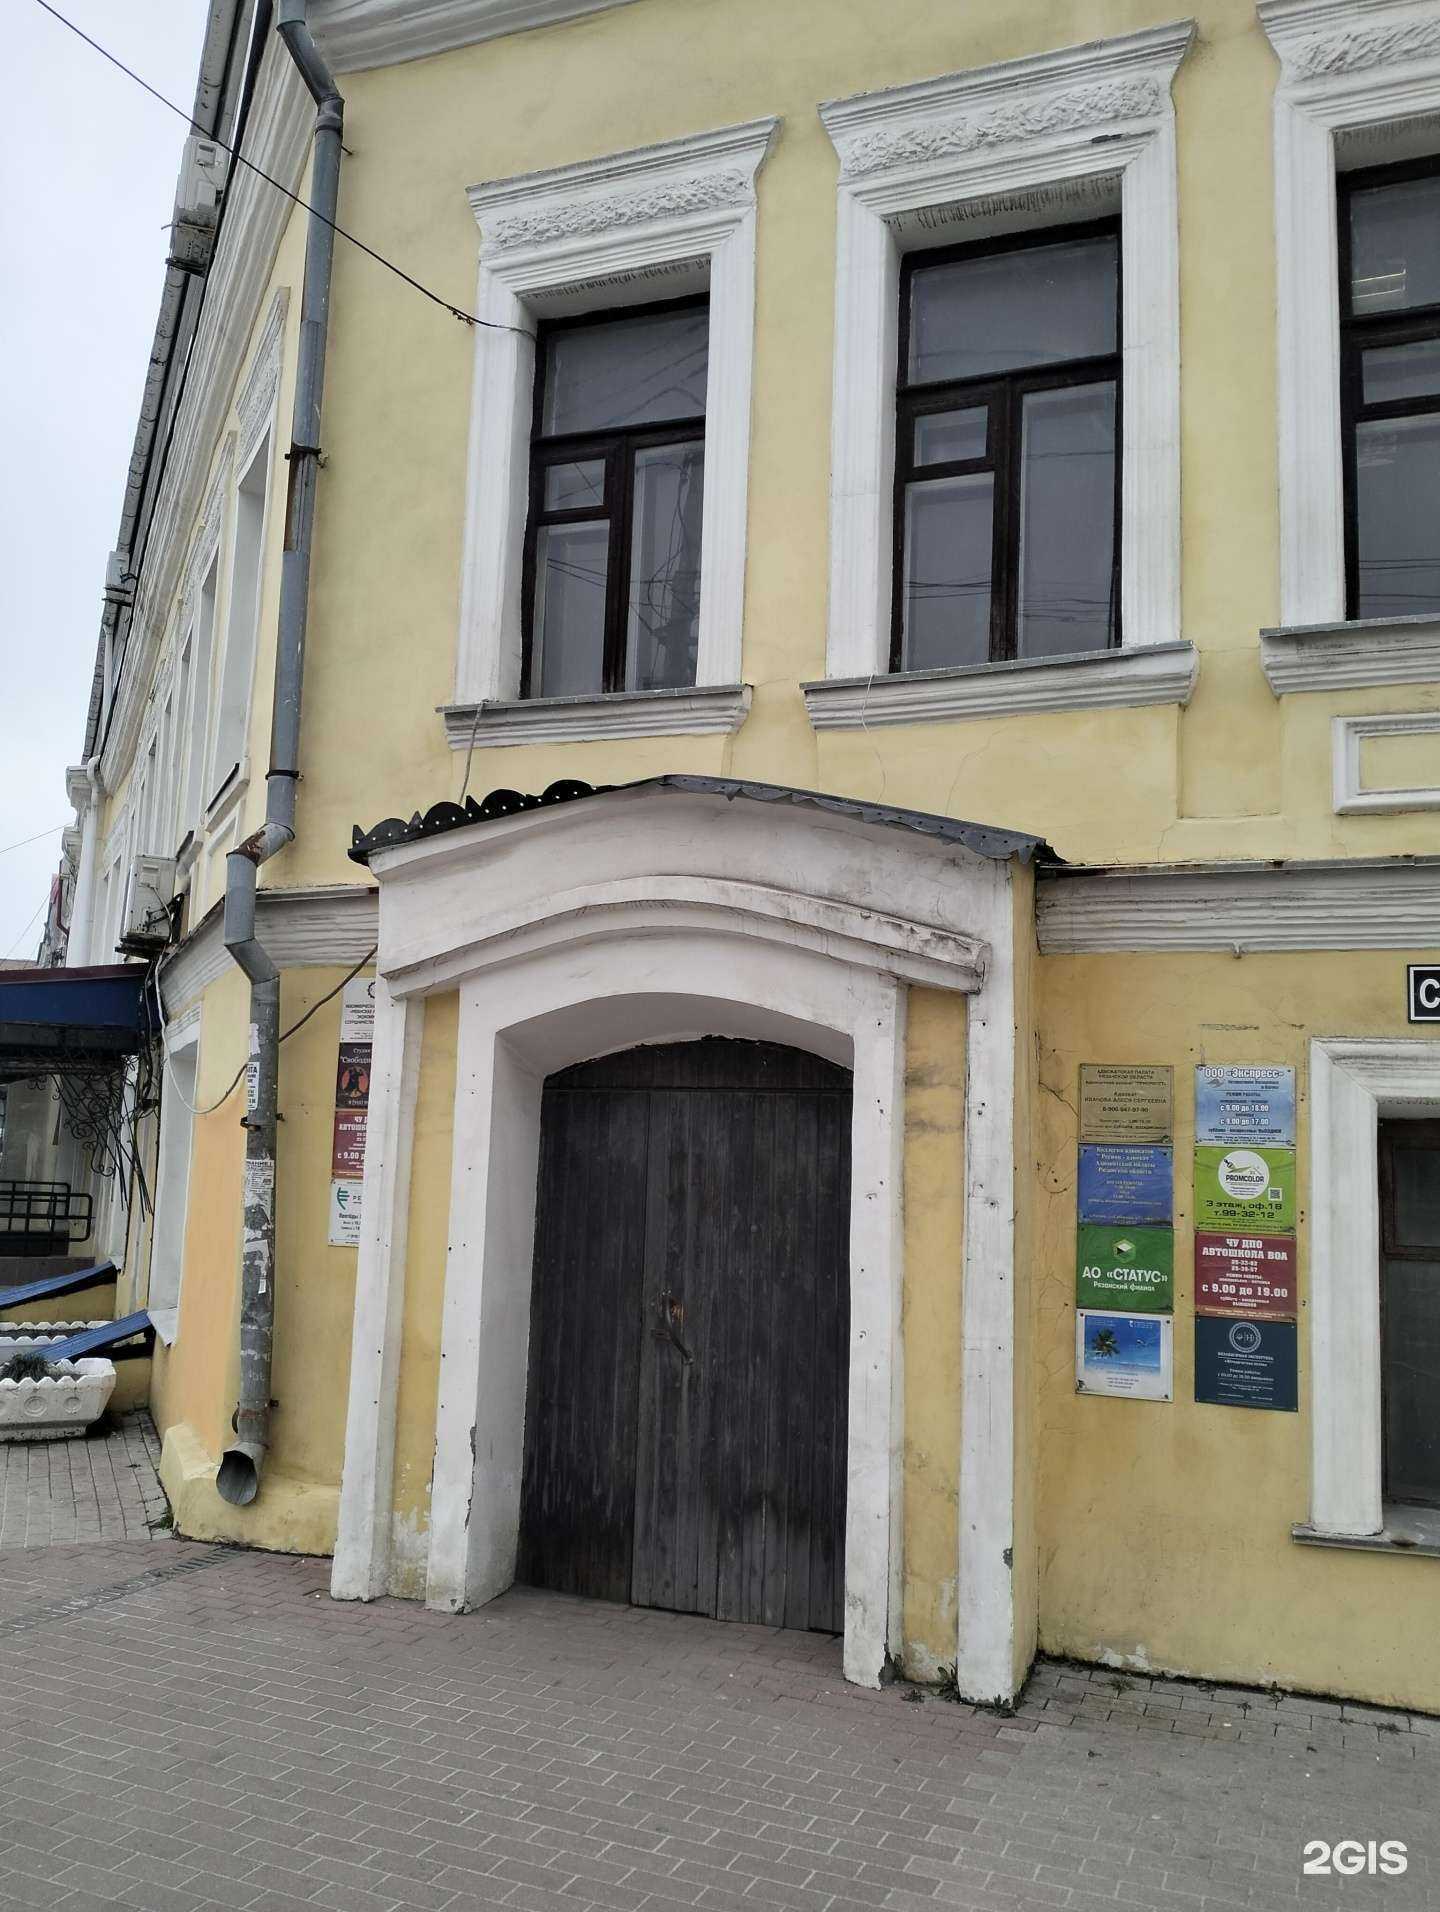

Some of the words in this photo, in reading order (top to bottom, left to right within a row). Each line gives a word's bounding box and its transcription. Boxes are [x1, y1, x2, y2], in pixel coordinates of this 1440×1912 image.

[1205, 1068, 1223, 1077] ООО
[1225, 1174, 1265, 1183] PROMCOLOR
[1226, 1238, 1240, 1247] ЧУ
[1242, 1239, 1263, 1249] ДПО
[1202, 1247, 1264, 1259] АВТОШКОЛА
[1267, 1251, 1288, 1261] ВОА
[1082, 1266, 1102, 1279] АО
[1106, 1268, 1168, 1283] «СТАТУС»
[1212, 1284, 1236, 1293] 9.00
[1239, 1287, 1253, 1295] до
[1257, 1286, 1288, 1298] 19.00
